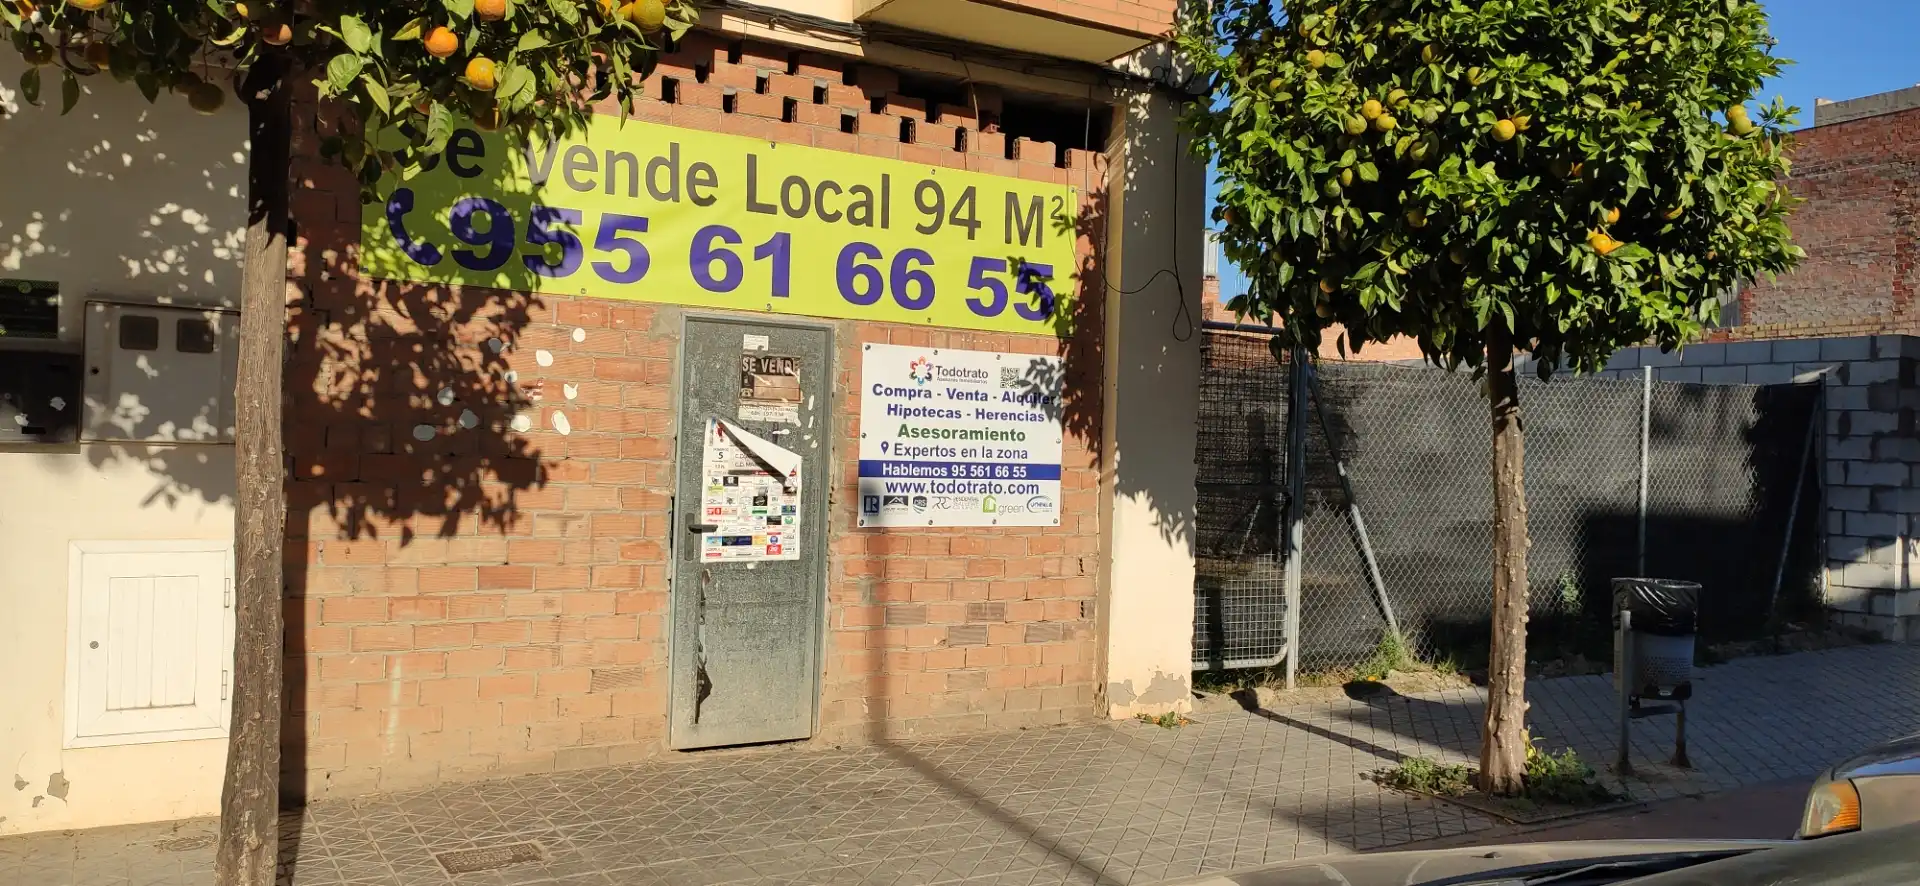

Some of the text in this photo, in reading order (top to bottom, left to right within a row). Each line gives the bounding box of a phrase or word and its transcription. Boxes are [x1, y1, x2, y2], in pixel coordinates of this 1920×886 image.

[523, 124, 719, 207] Vende
[745, 153, 891, 230] Local
[914, 178, 982, 241] 94
[451, 197, 1055, 321] 955 61 66 55
[742, 356, 757, 373] SE
[935, 365, 989, 379] Todotrato
[872, 383, 932, 400] Compra
[946, 387, 989, 402] Venta
[1001, 391, 1056, 407] Alquiler
[886, 403, 962, 419] Hipotecas
[975, 408, 1045, 422] Herencias
[897, 423, 1026, 442] Asesoramiento
[893, 442, 1028, 460] Expertos en la zona
[882, 463, 1027, 478] Hablemos 95 561 66 55
[885, 479, 1040, 495] www.todotrato.com
[998, 505, 1025, 516] green
